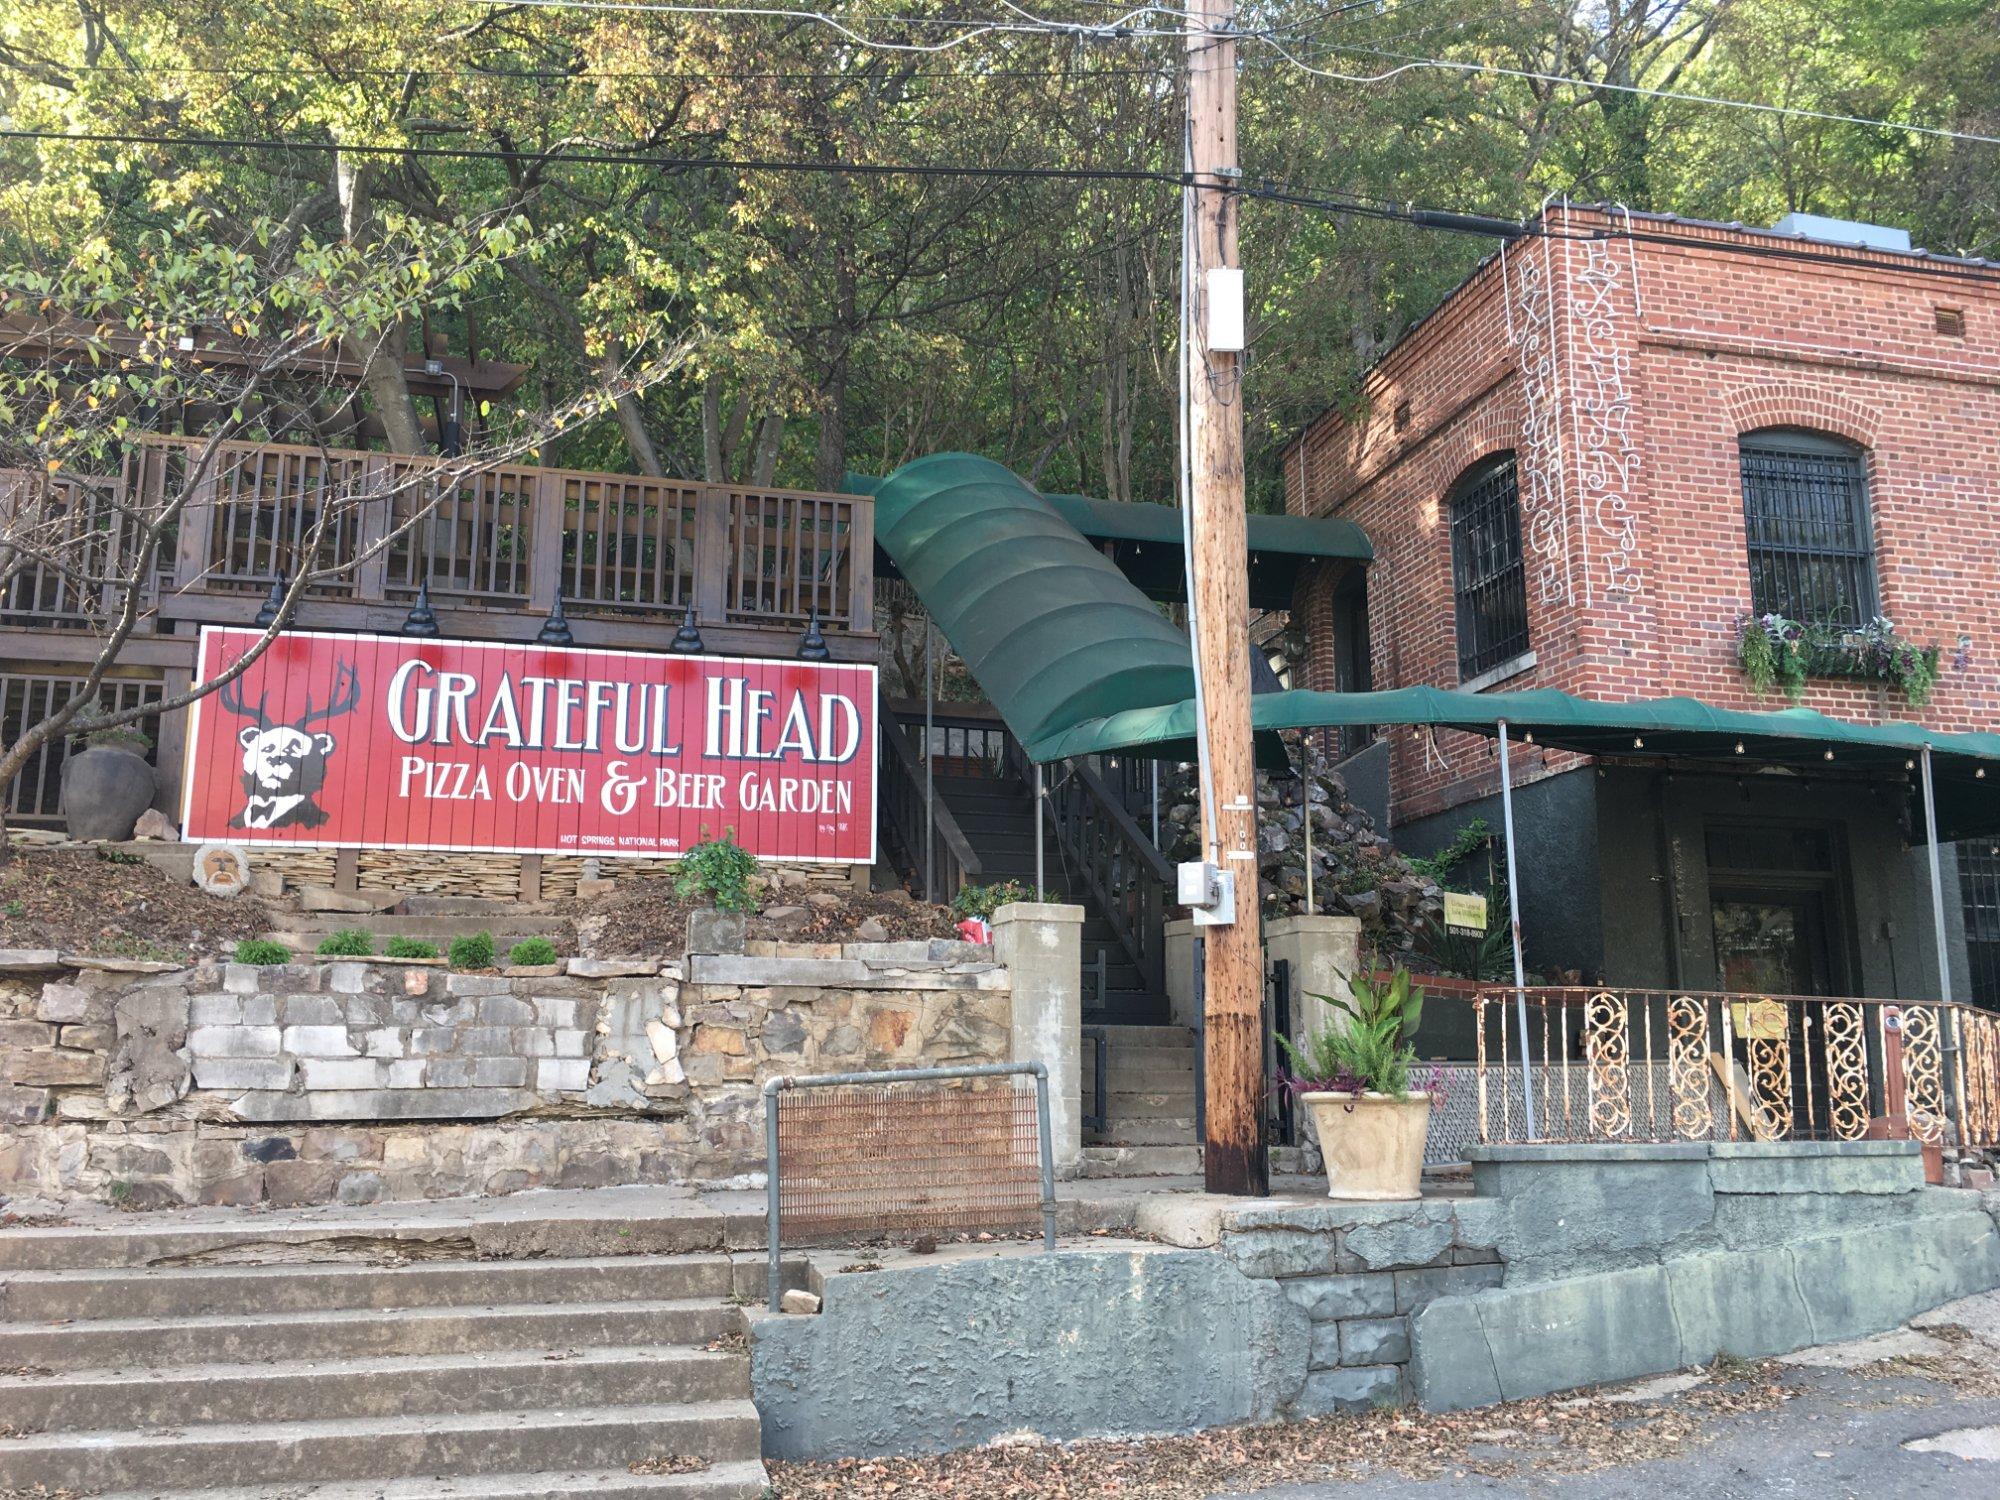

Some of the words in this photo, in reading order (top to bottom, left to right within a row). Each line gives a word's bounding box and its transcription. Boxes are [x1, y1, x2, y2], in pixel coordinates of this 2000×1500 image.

[1514, 253, 1563, 605] EXCHANGE
[1576, 240, 1642, 591] EXCHANGE
[387, 658, 681, 756] GRATEFUL
[701, 676, 862, 765] HEAD
[398, 756, 492, 801] PIZZA
[505, 761, 586, 804] OVEN
[600, 760, 648, 816] &
[653, 767, 727, 810] BEER
[738, 771, 852, 815] GARDEN
[560, 834, 578, 844] HOT
[581, 835, 616, 847] SPRINGS
[618, 836, 658, 847] NATIONAL
[659, 838, 680, 848] PARK
